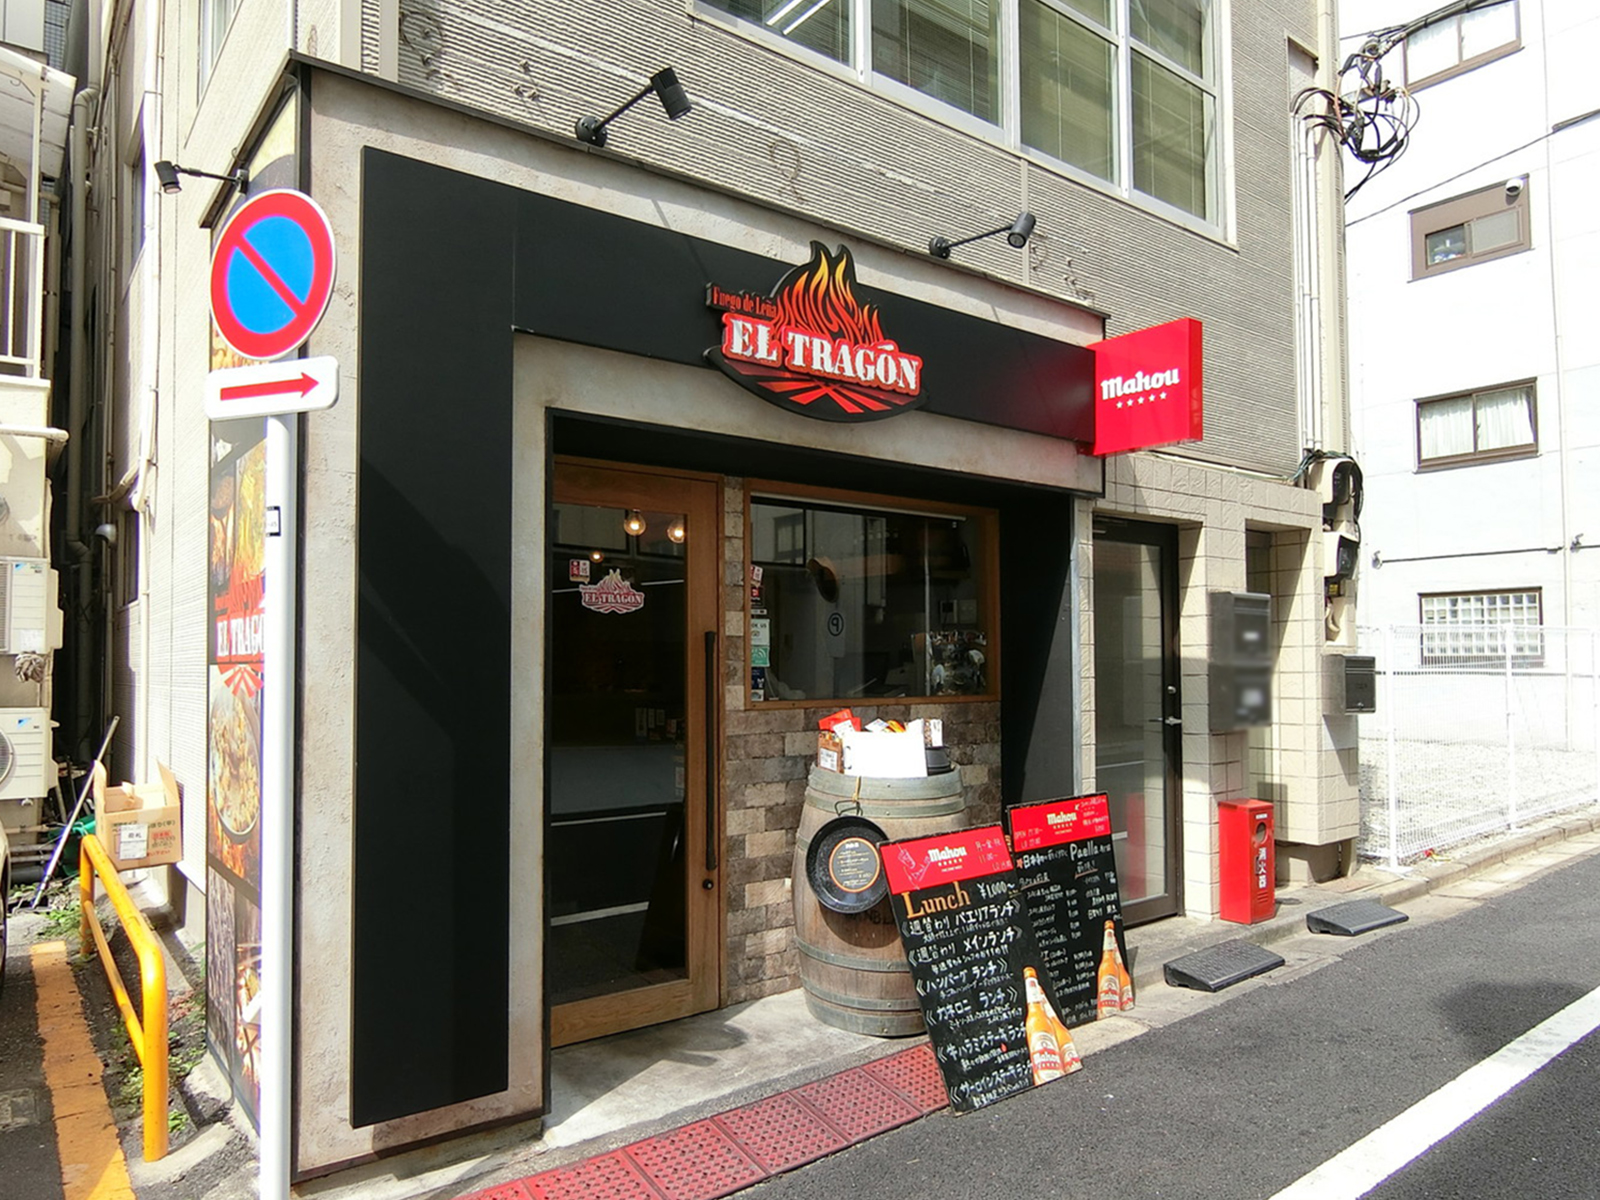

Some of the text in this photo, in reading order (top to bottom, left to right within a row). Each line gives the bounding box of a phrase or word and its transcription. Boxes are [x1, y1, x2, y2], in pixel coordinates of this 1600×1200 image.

[743, 294, 754, 312] de
[731, 319, 778, 361] EL
[1101, 368, 1180, 400] Mahou
[928, 846, 967, 862] Mahou
[1069, 840, 1099, 861] Paella
[901, 881, 971, 919] Lunch
